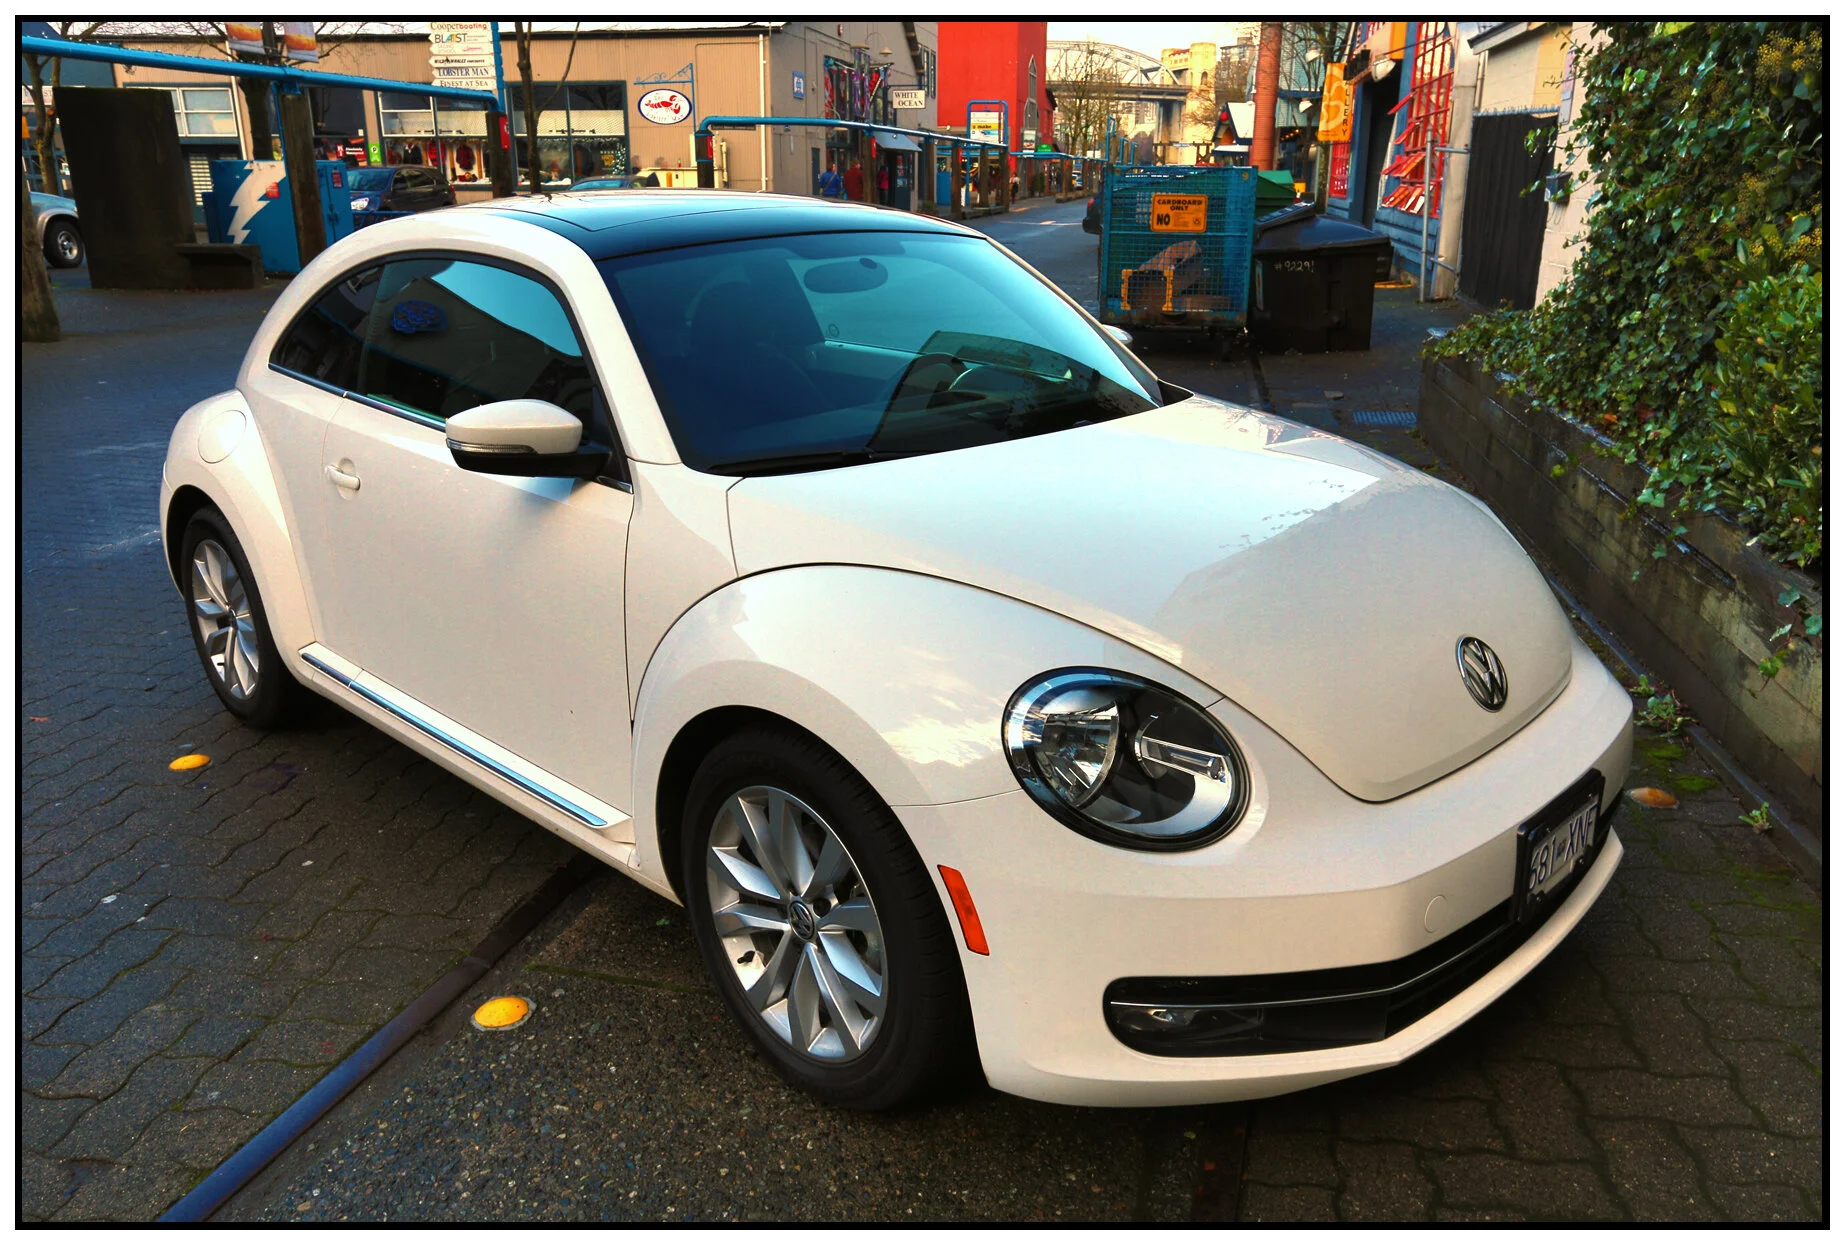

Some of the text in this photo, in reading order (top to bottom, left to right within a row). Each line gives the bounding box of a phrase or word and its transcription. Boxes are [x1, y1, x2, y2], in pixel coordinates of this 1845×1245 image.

[434, 33, 467, 43] BLAST
[438, 68, 489, 76] LOBSTER MAN
[1342, 80, 1350, 136] ALLERY
[1156, 213, 1170, 226] NO
